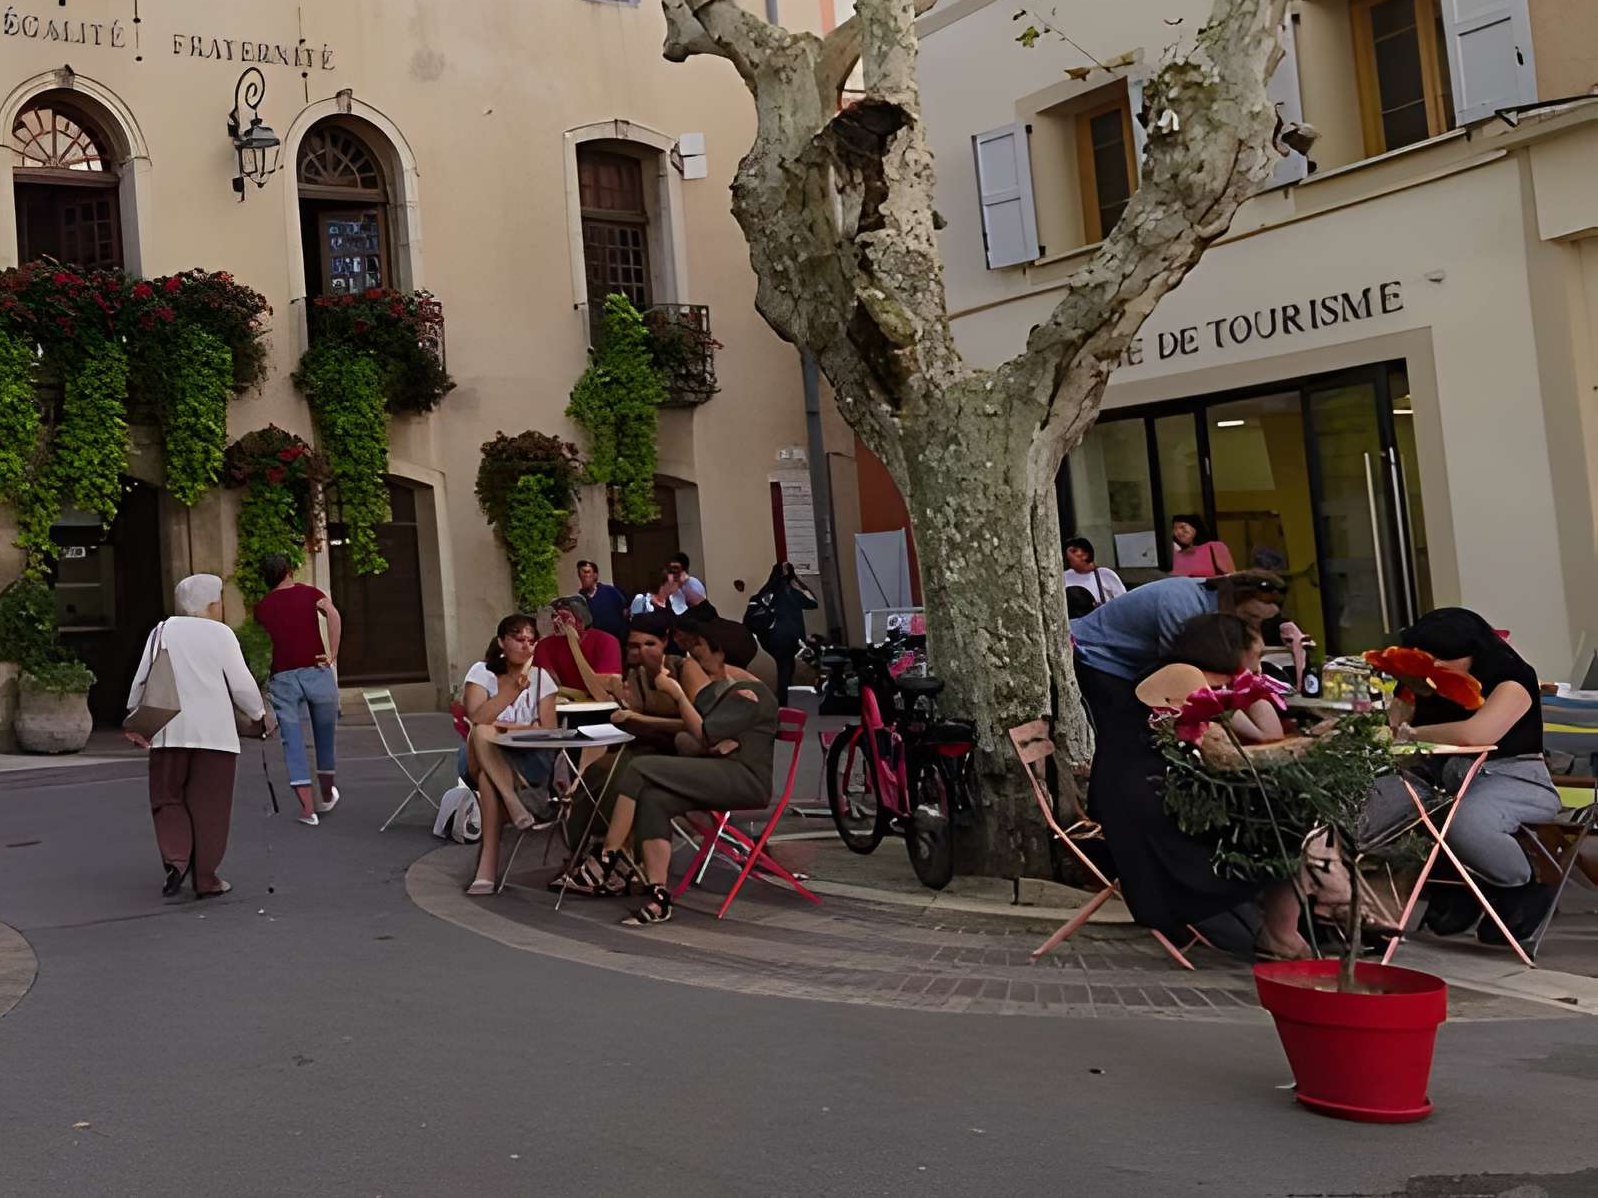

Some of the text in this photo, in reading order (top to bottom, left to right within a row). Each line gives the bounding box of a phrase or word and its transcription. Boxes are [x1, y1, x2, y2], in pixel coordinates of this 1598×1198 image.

[3, 5, 126, 48] ÉGALITÉ
[173, 33, 336, 71] FRATERNITÉ
[1157, 326, 1200, 360] DE
[1207, 280, 1405, 349] TOURISME
